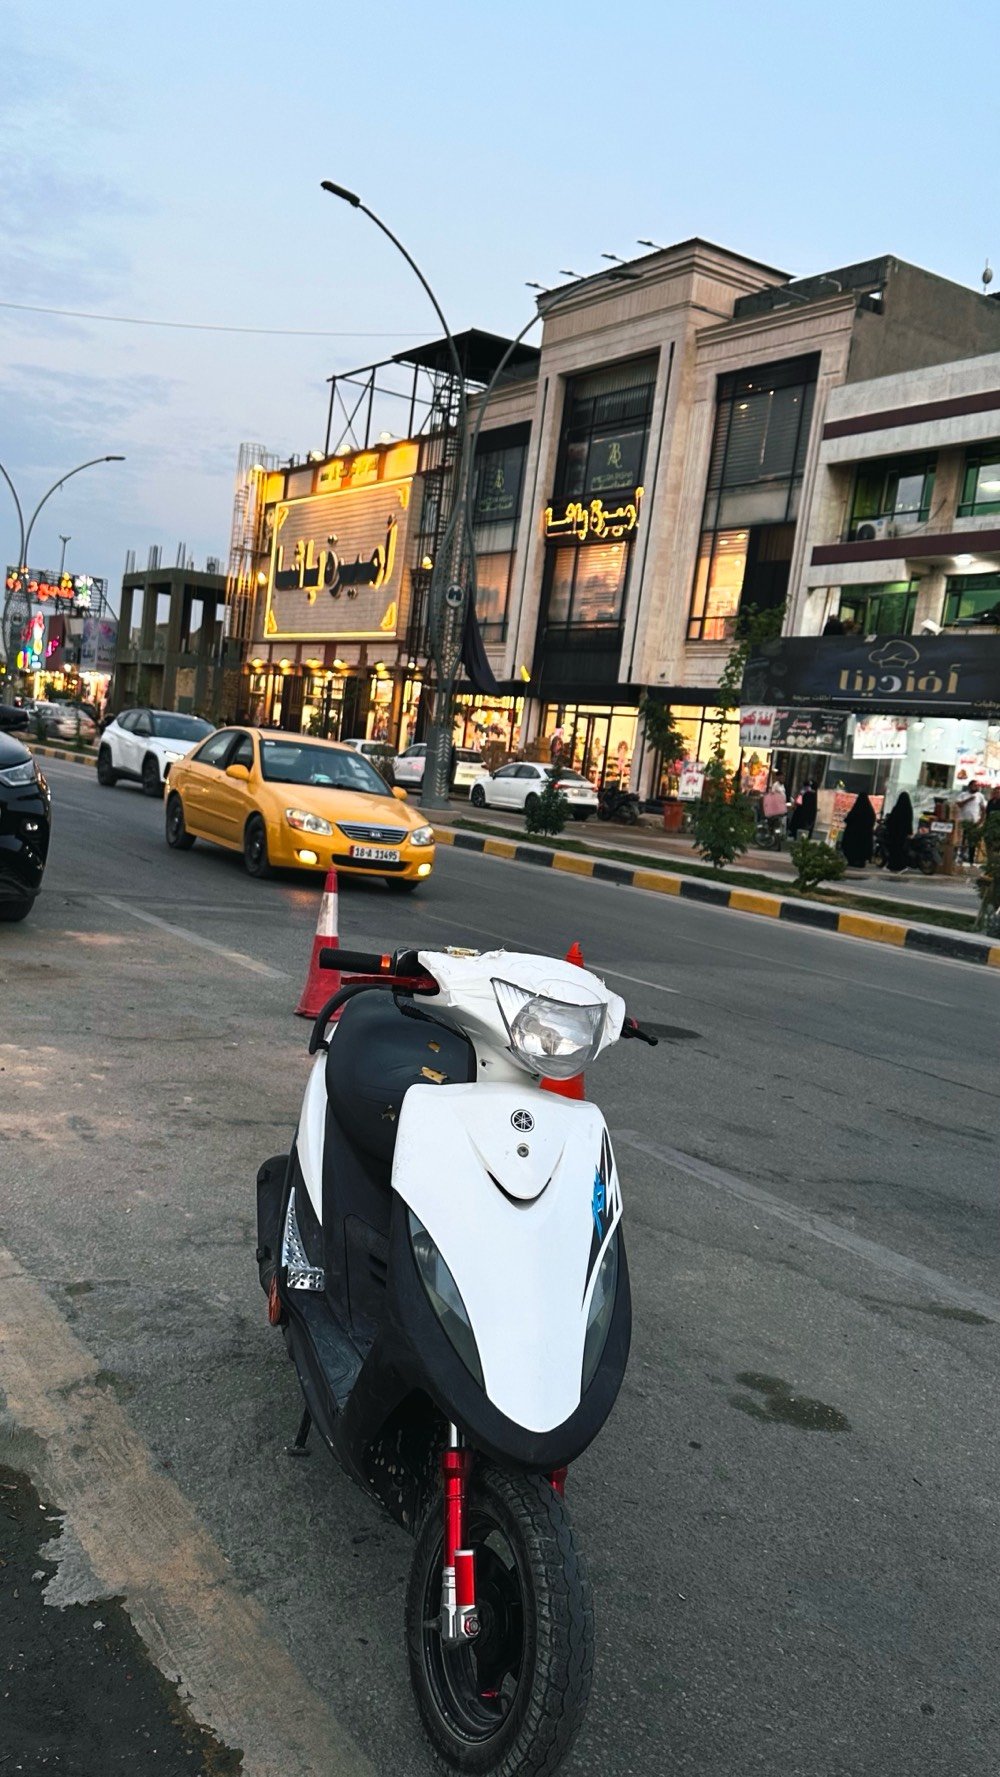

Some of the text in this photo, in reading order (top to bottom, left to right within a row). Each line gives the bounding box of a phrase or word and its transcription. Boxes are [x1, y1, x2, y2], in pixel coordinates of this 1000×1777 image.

[276, 539, 327, 606] باشا
[839, 663, 961, 697] أفندينا
[375, 850, 399, 861] 11495
